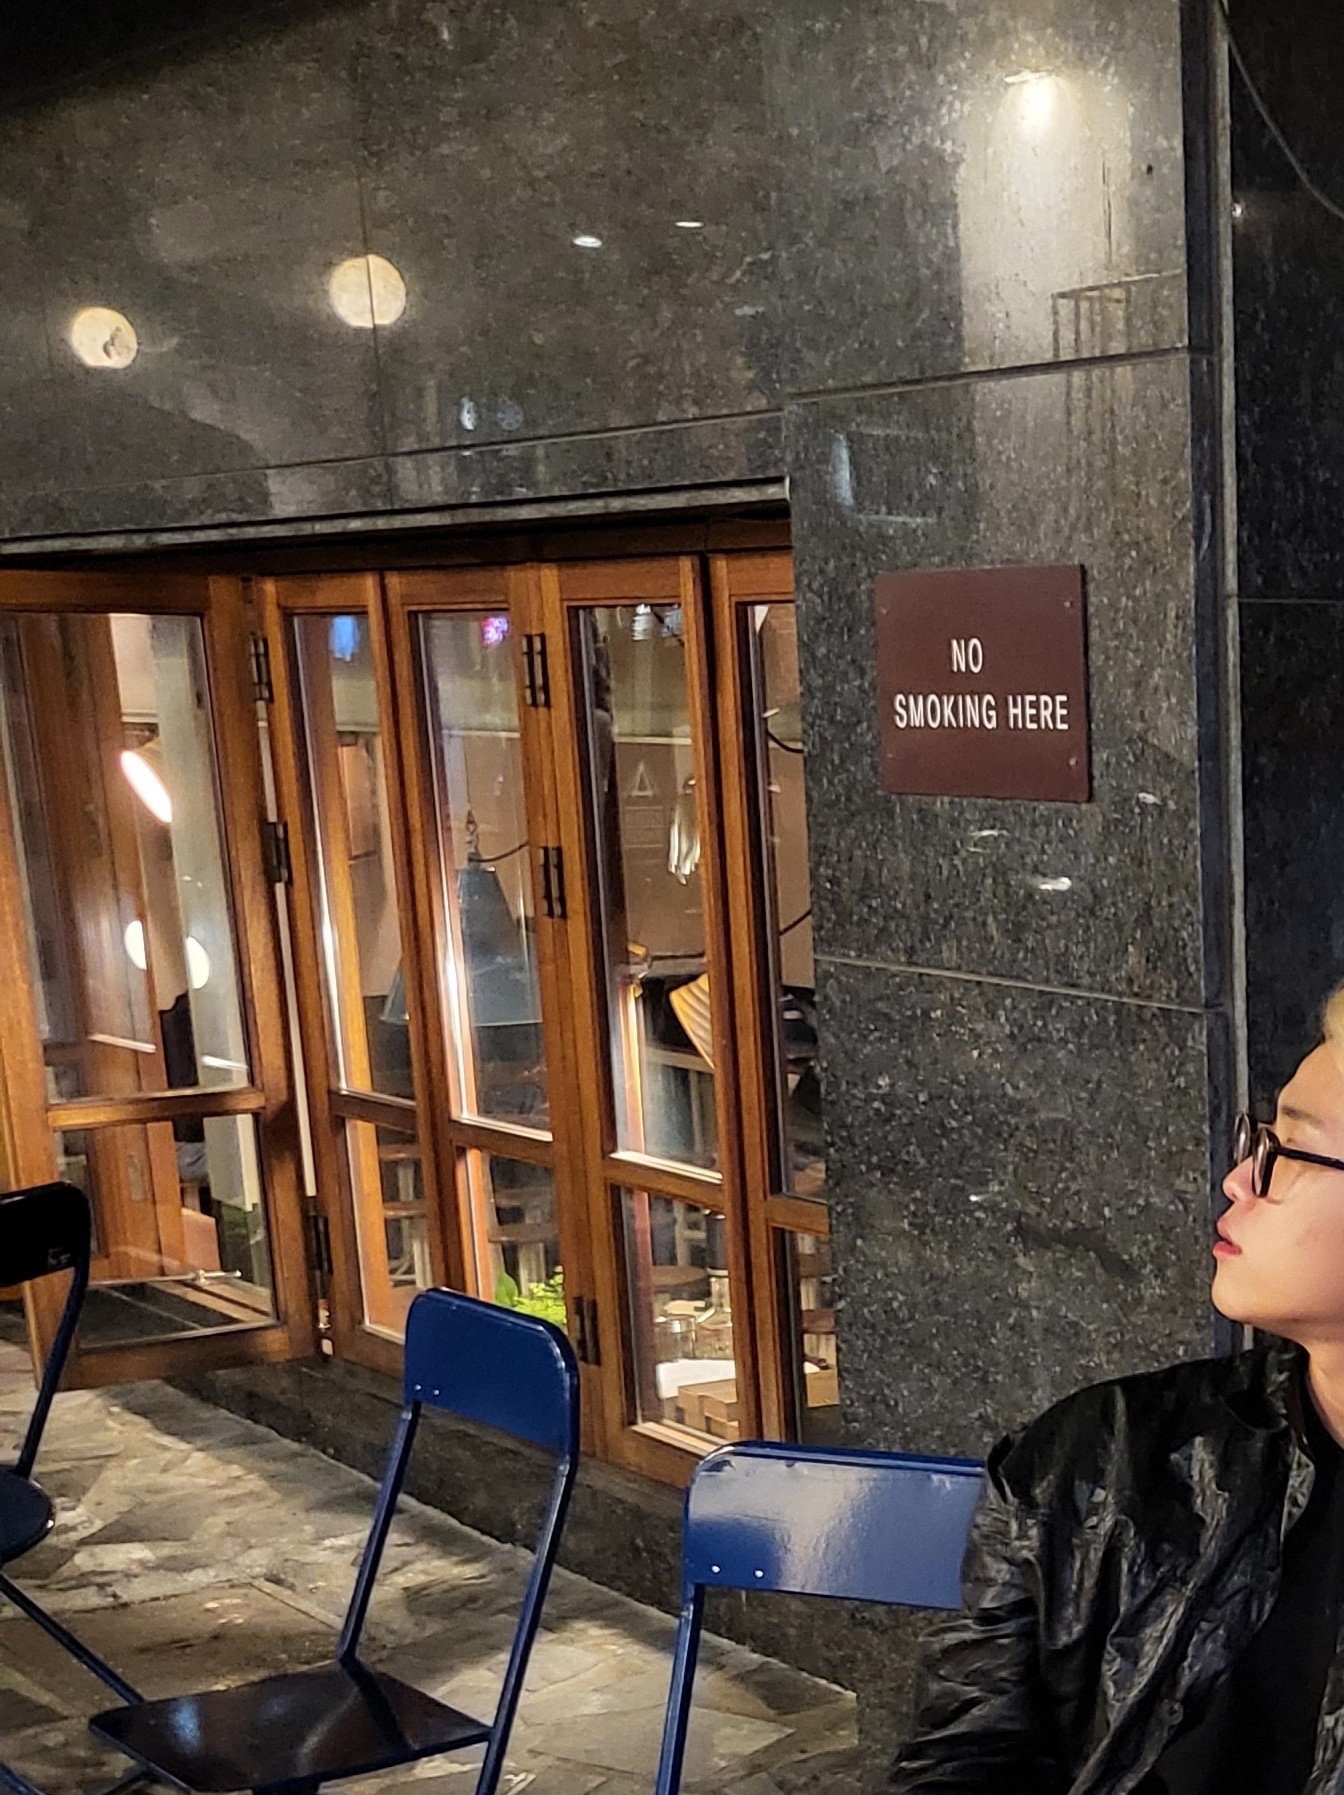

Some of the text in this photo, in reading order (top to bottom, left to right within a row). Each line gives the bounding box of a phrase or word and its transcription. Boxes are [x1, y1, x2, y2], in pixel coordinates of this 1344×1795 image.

[951, 638, 984, 674] NO
[894, 693, 1069, 731] SMOKING HERE
